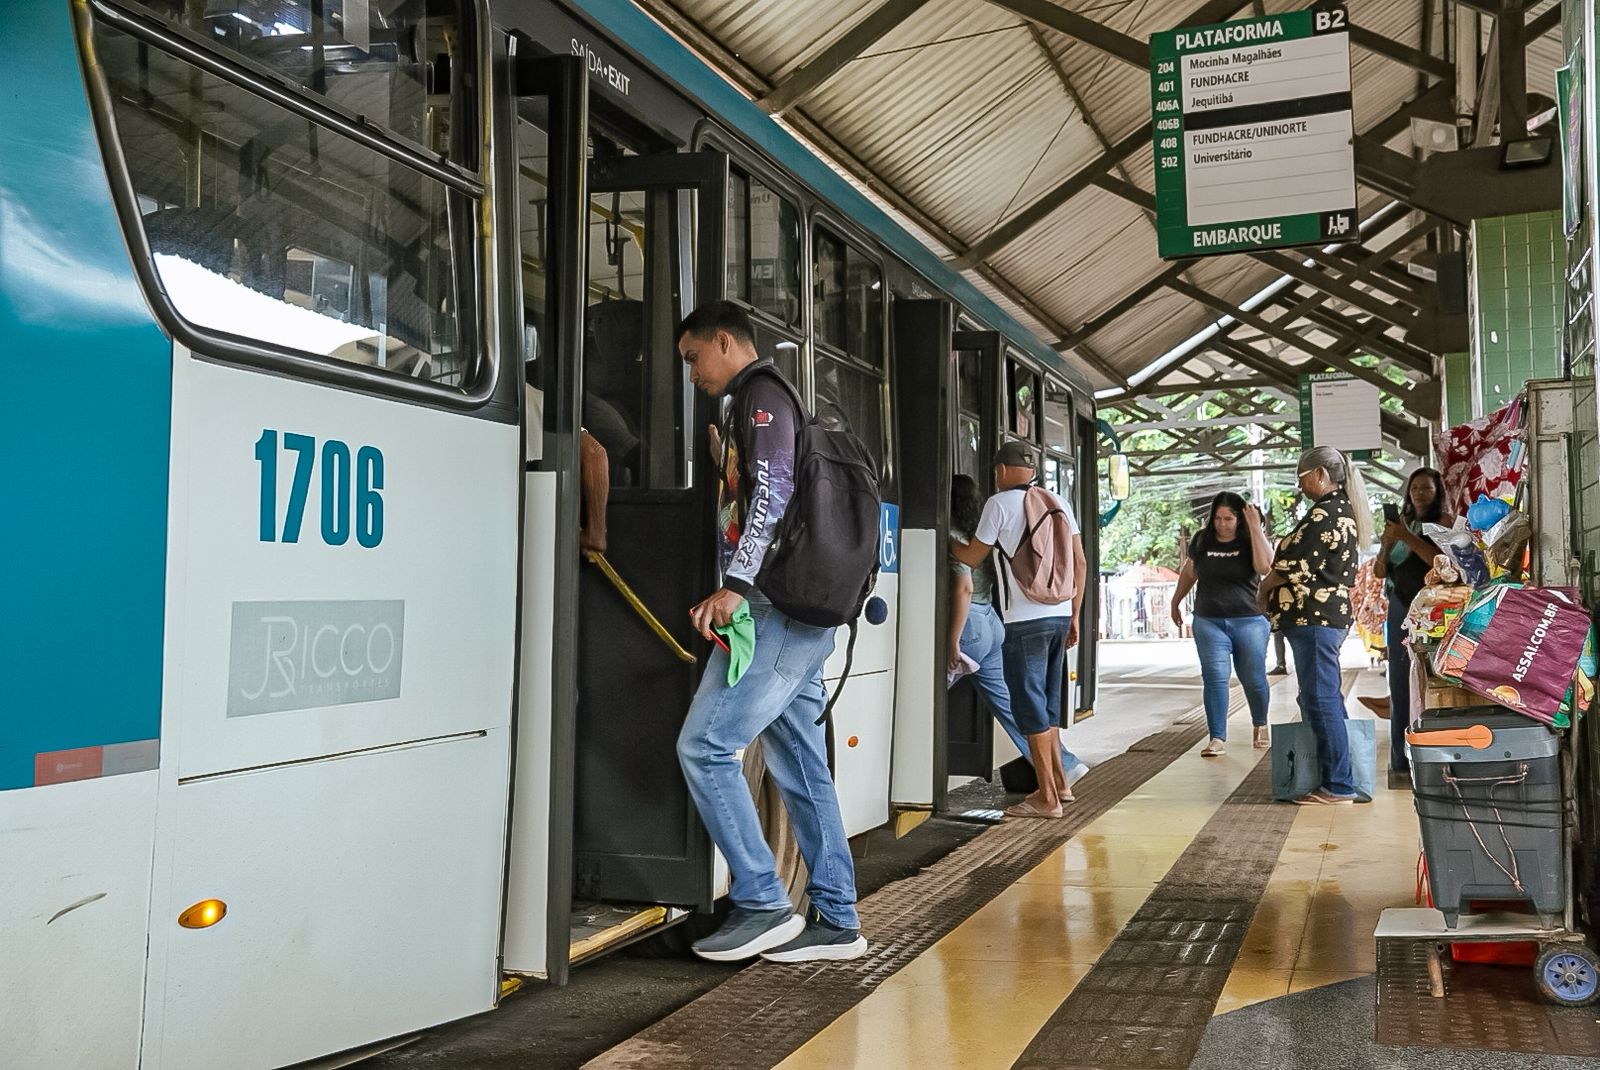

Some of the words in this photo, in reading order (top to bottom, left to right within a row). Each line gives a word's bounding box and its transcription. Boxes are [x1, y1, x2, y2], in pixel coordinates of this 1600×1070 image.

[1315, 9, 1345, 31] B2
[1176, 20, 1284, 50] PLATAFORMA
[1157, 61, 1175, 74] 204
[1190, 54, 1230, 70] Mocinha
[1232, 49, 1282, 65] Magalhães
[1158, 80, 1174, 93] 401
[1190, 71, 1250, 89] FUNDHACRE
[1156, 99, 1179, 112] 406A
[1191, 92, 1234, 109] Jequitibá
[1160, 137, 1178, 149] 408
[1192, 121, 1308, 146] FUNDHACRE/UNINORTE
[1161, 156, 1178, 168] 502
[1194, 149, 1253, 164] Universitário
[1193, 223, 1282, 247] EMBARQUE
[255, 428, 384, 549] 1706
[1512, 603, 1560, 683] ASSAI.COM.BR
[241, 616, 395, 700] RICCO
